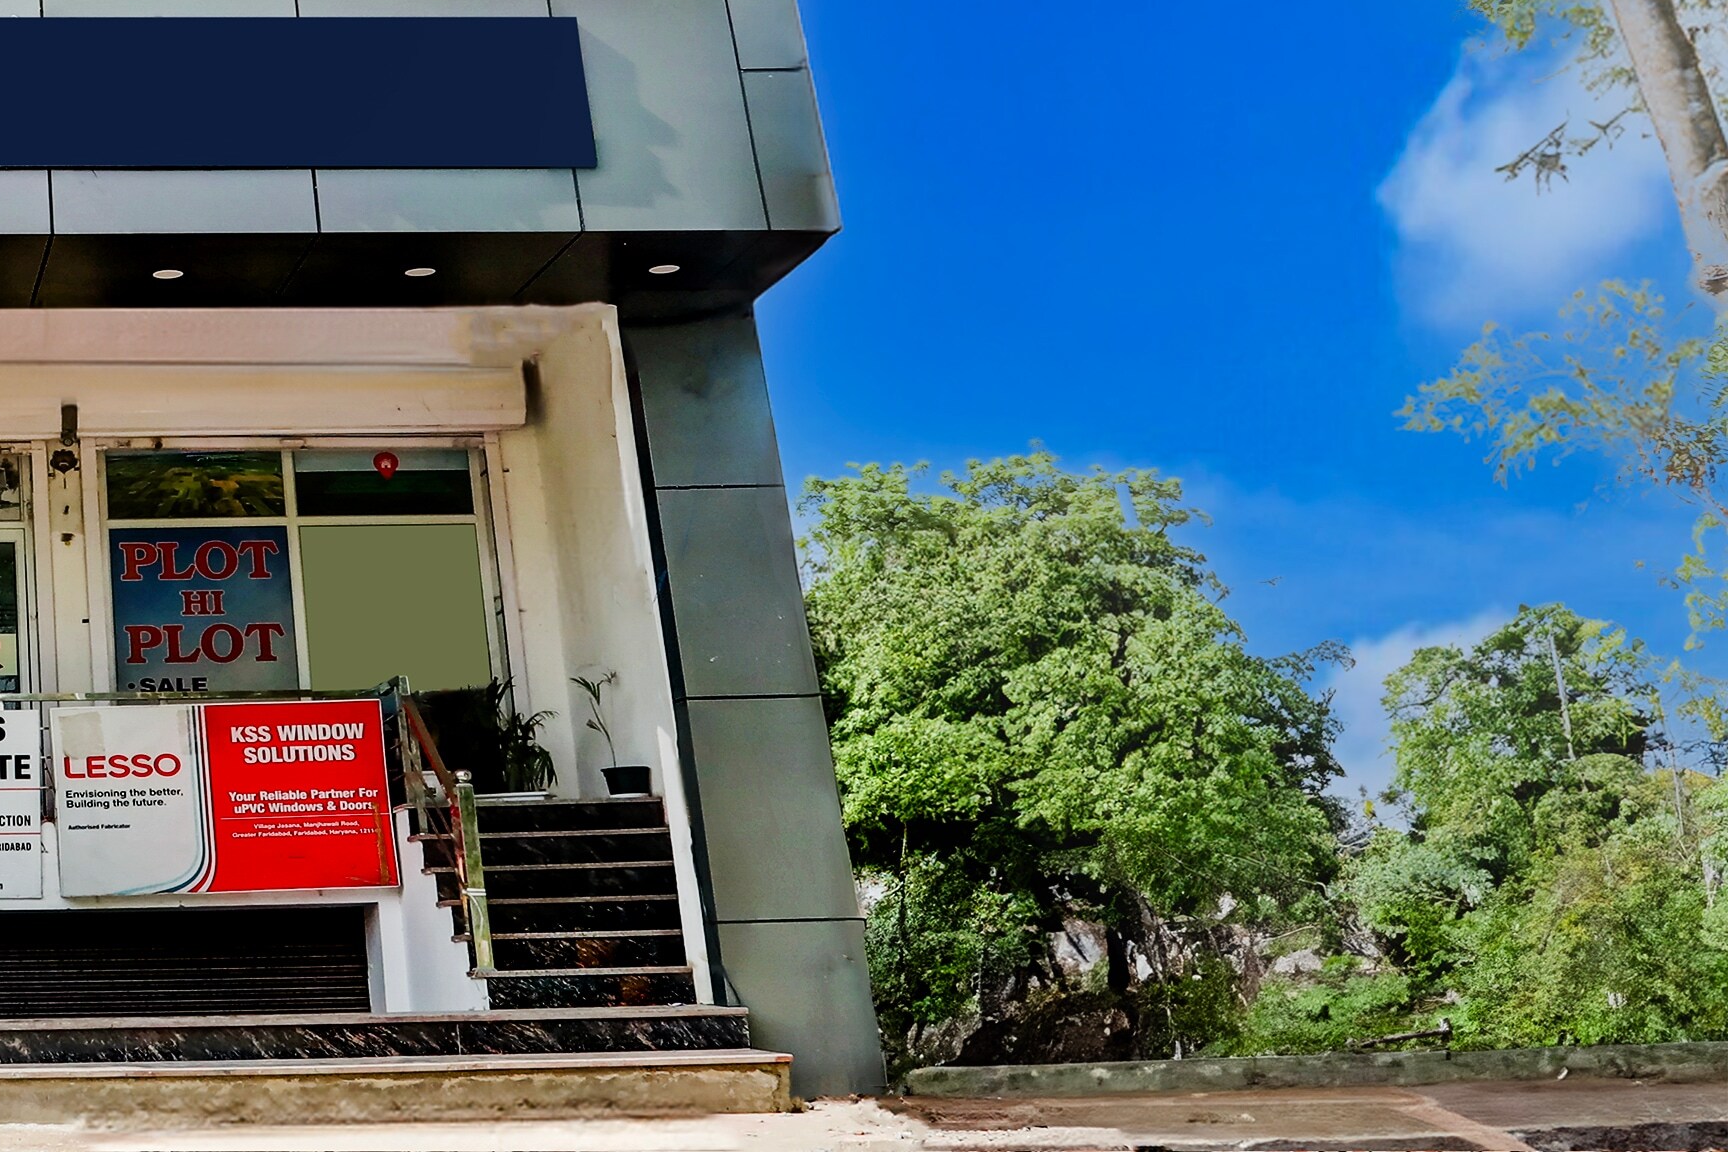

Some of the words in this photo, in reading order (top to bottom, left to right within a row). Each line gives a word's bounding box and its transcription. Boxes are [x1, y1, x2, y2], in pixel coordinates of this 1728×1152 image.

[118, 540, 280, 581] PLOT
[179, 589, 226, 616] HI
[124, 622, 285, 664] PLOT
[139, 677, 209, 692] SALE
[231, 726, 271, 743] KSS
[277, 723, 364, 742] WINDOW
[243, 744, 355, 764] SOLUTIONS
[63, 753, 182, 779] LESSO
[65, 790, 127, 799] Envisioning
[129, 789, 147, 797] the
[66, 800, 110, 809] Building
[112, 799, 130, 807] the
[132, 798, 167, 807] future.
[229, 791, 256, 802] Your
[260, 790, 307, 801] Reliable
[311, 789, 356, 799] Partner
[358, 787, 378, 798] For
[234, 803, 265, 814] uPVC
[269, 802, 324, 813] Windows
[327, 800, 336, 811] &
[339, 800, 374, 811] Doors
